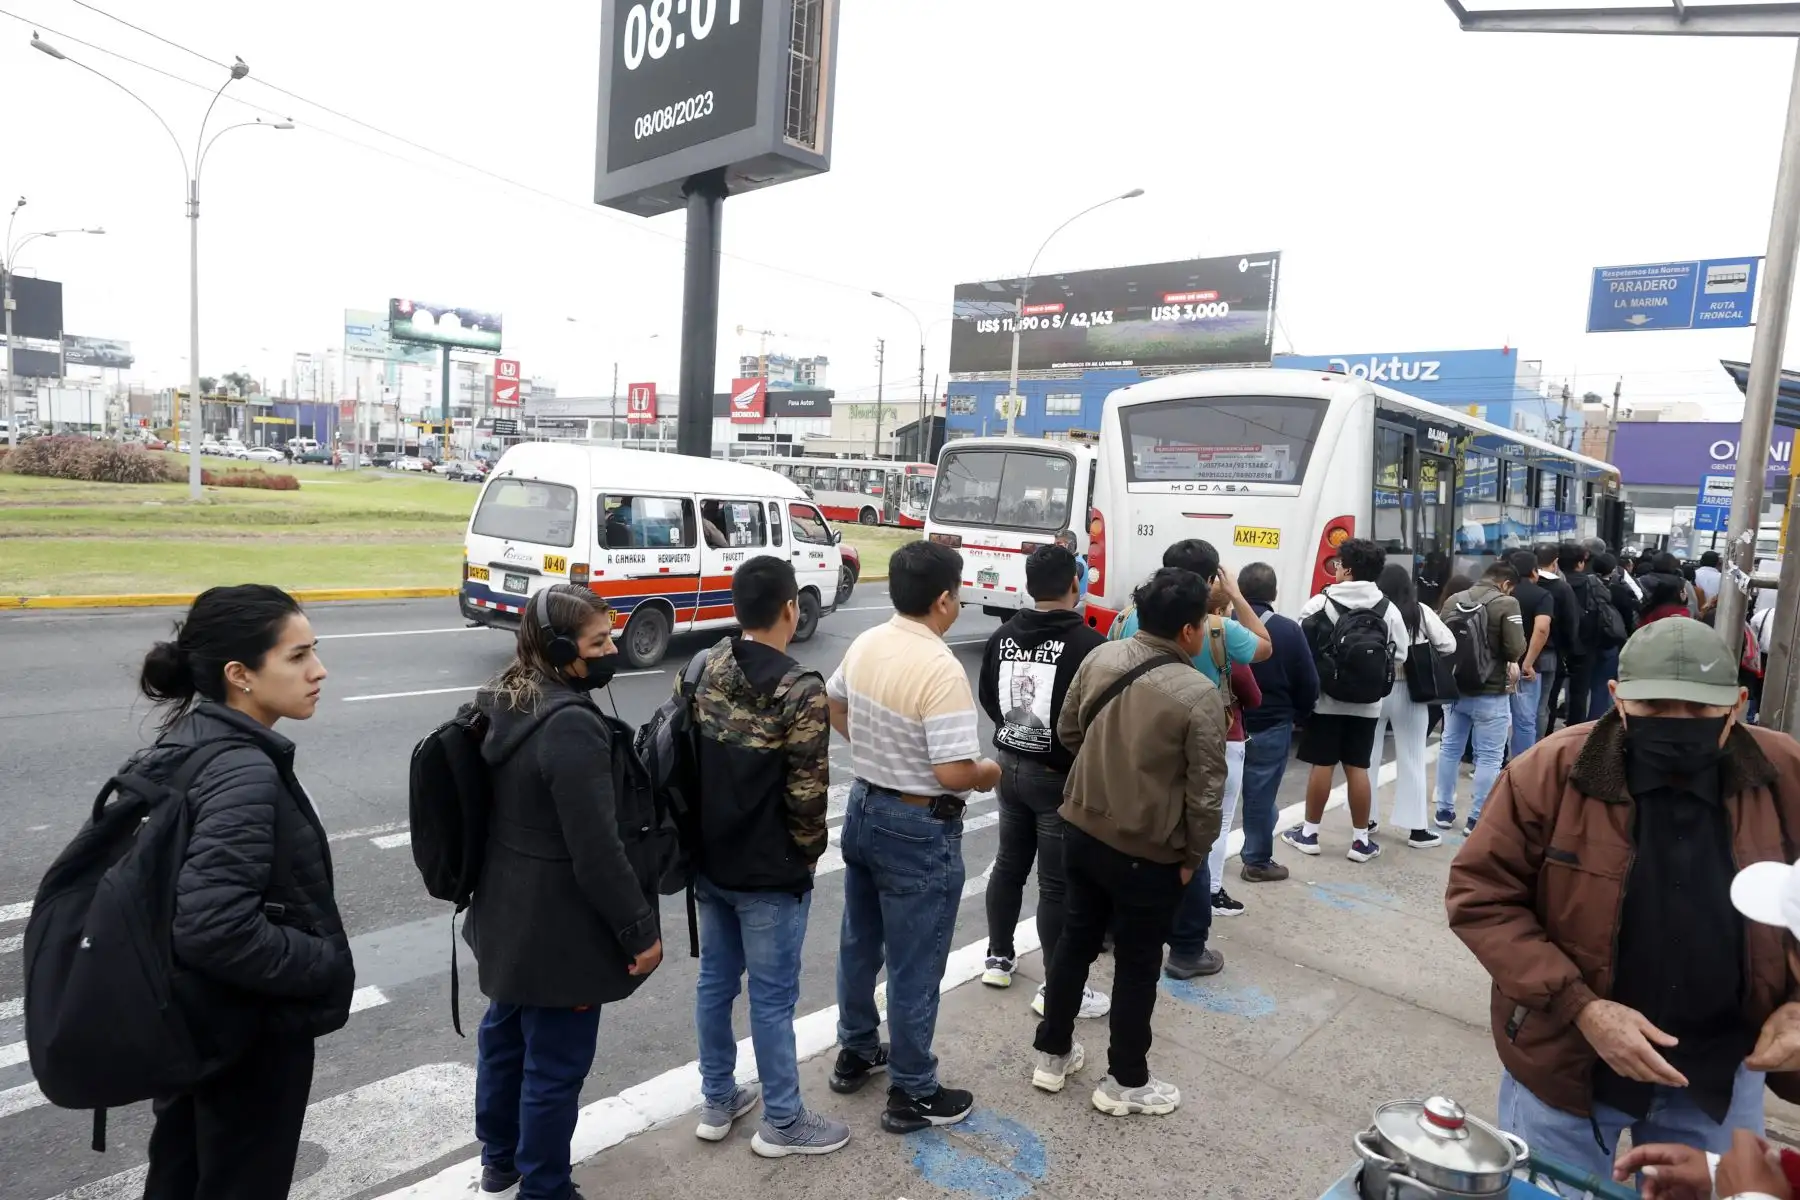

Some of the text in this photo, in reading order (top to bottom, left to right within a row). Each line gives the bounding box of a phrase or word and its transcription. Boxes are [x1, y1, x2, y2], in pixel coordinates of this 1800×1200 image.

[634, 91, 714, 139] 08/08/2023
[1602, 269, 1647, 278] Respetemos
[1660, 266, 1690, 274] Normas
[1610, 279, 1677, 293] PARADERO
[1614, 297, 1668, 308] LA MARINA
[1710, 301, 1735, 310] RUTA
[1151, 302, 1229, 321] US$ 3,000
[1700, 310, 1743, 320] TRONCAL
[977, 318, 1000, 333] US$
[1052, 312, 1068, 329] S/
[1709, 440, 1791, 462] ONI
[1171, 484, 1250, 493] MODASA
[1702, 496, 1732, 505] PARADE
[1137, 524, 1154, 536] 833
[1235, 528, 1279, 545] AXH-733
[616, 554, 646, 564] GAMARRA
[658, 553, 690, 563] AEROPUERTO
[723, 552, 744, 562] FAUCETT
[1000, 637, 1020, 649] LO
[1005, 649, 1032, 661] CAN
[1035, 650, 1061, 663] FLY
